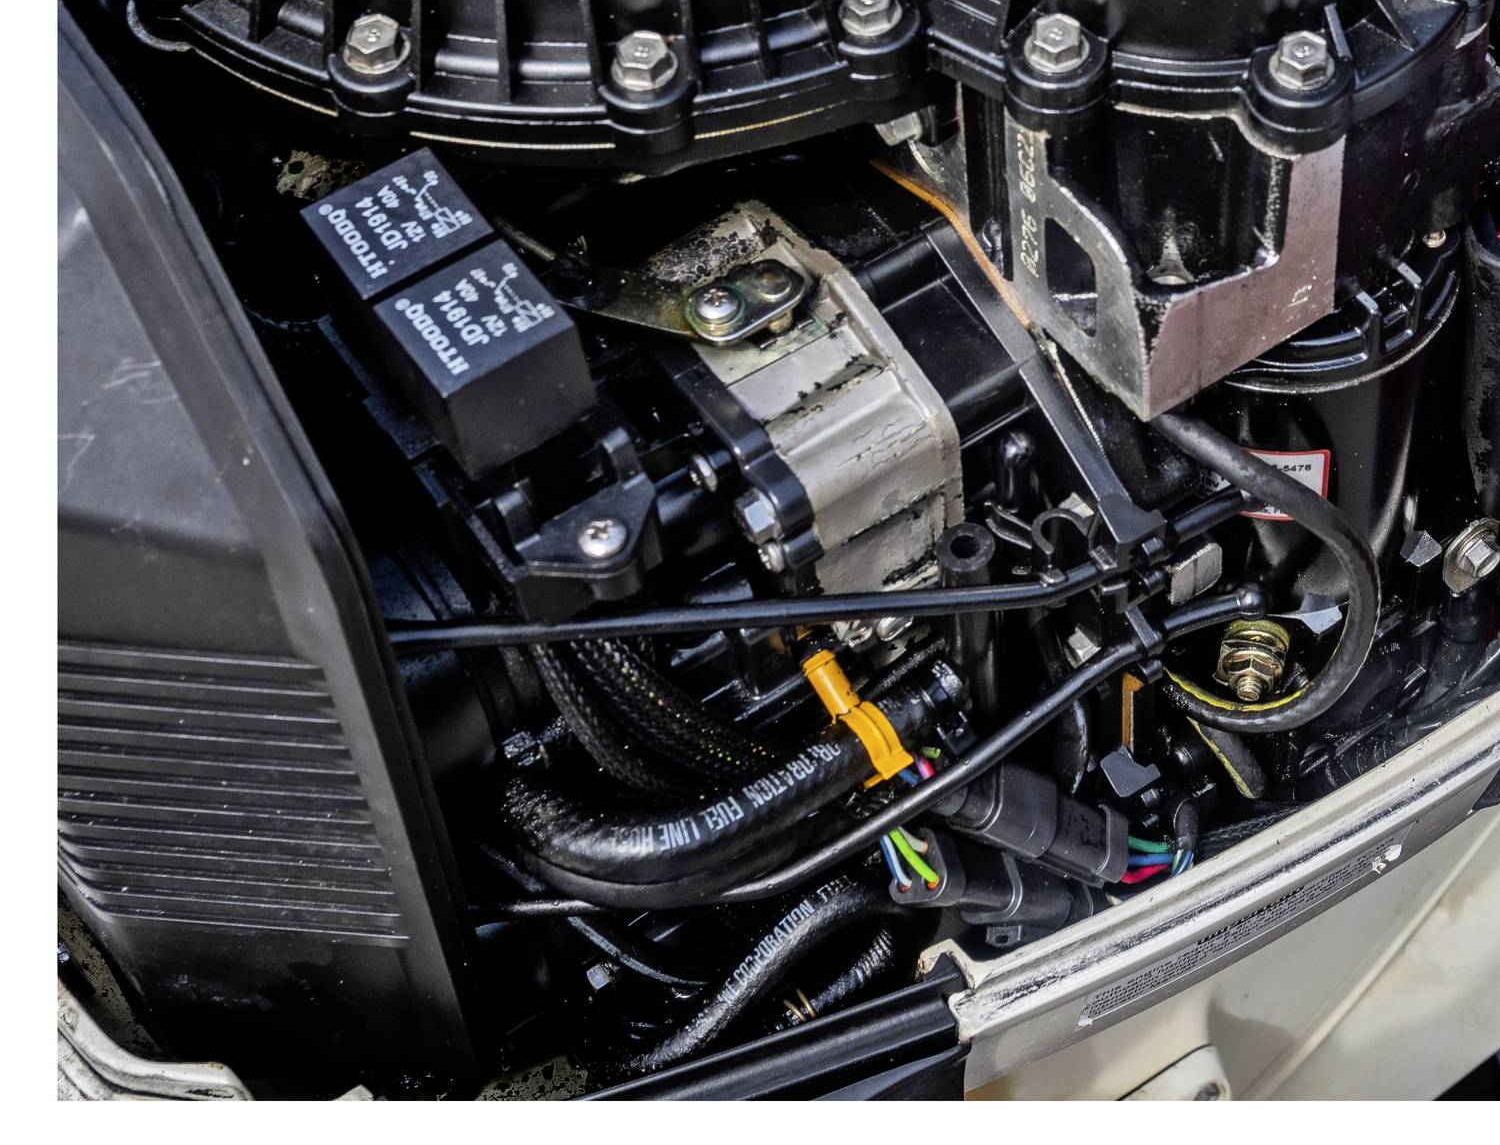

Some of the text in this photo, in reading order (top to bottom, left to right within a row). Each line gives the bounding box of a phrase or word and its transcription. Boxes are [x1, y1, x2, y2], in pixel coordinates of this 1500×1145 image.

[377, 185, 399, 208] 40A
[355, 197, 408, 250] JD1914
[400, 221, 426, 242] 12V
[455, 278, 479, 302] 40A
[433, 290, 490, 345] JD1914
[481, 315, 507, 337] 12V
[699, 796, 744, 832] FUEL
[658, 818, 701, 852] LINE
